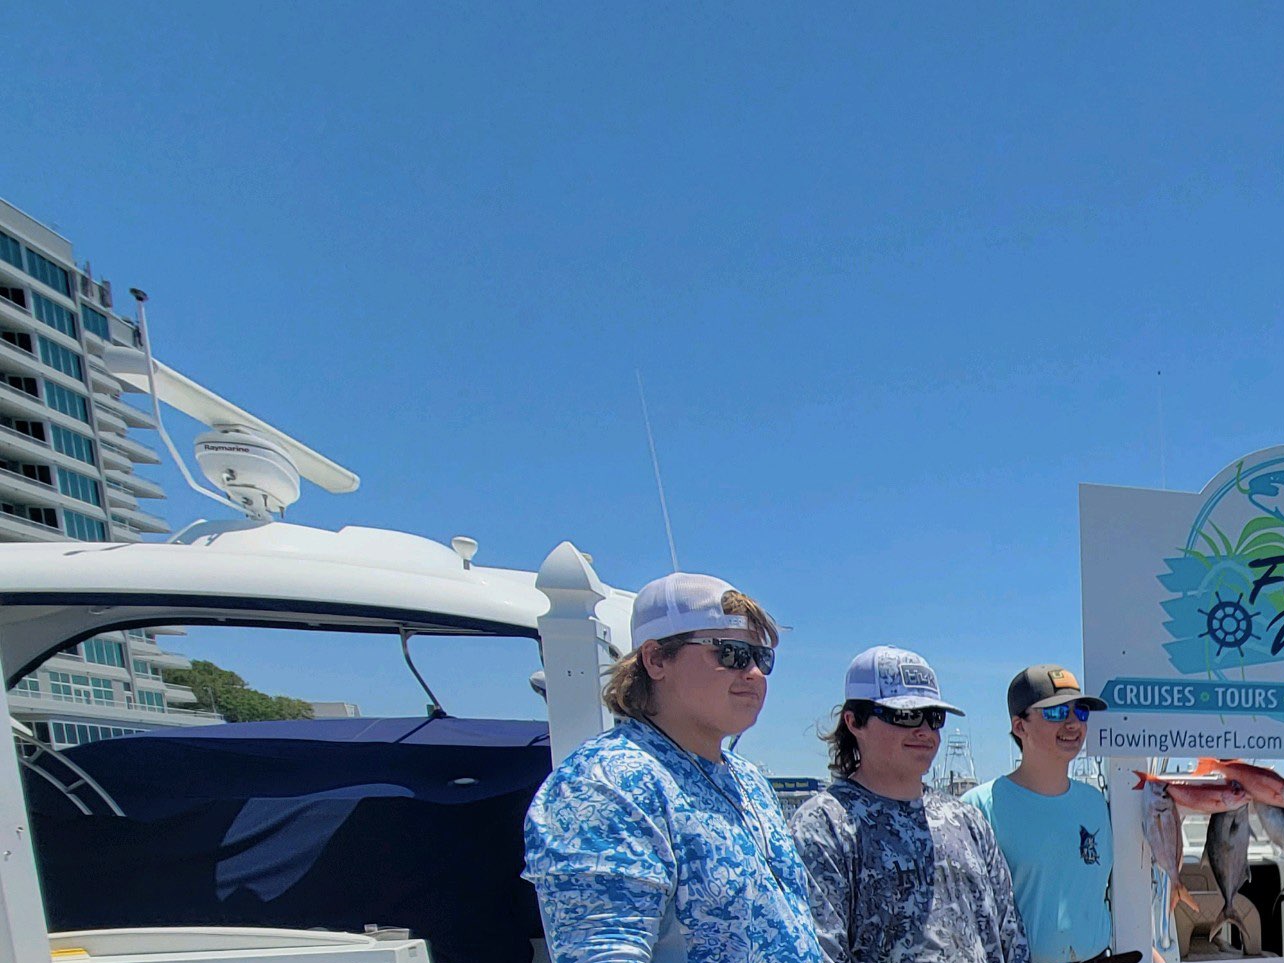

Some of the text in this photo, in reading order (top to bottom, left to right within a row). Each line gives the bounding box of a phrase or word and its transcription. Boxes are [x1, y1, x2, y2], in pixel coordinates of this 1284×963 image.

[204, 444, 250, 453] Raymarine
[1113, 684, 1195, 707] CRUISES
[1214, 687, 1278, 709] TOURS
[1099, 728, 1283, 752] FlowingWaterFL.com
